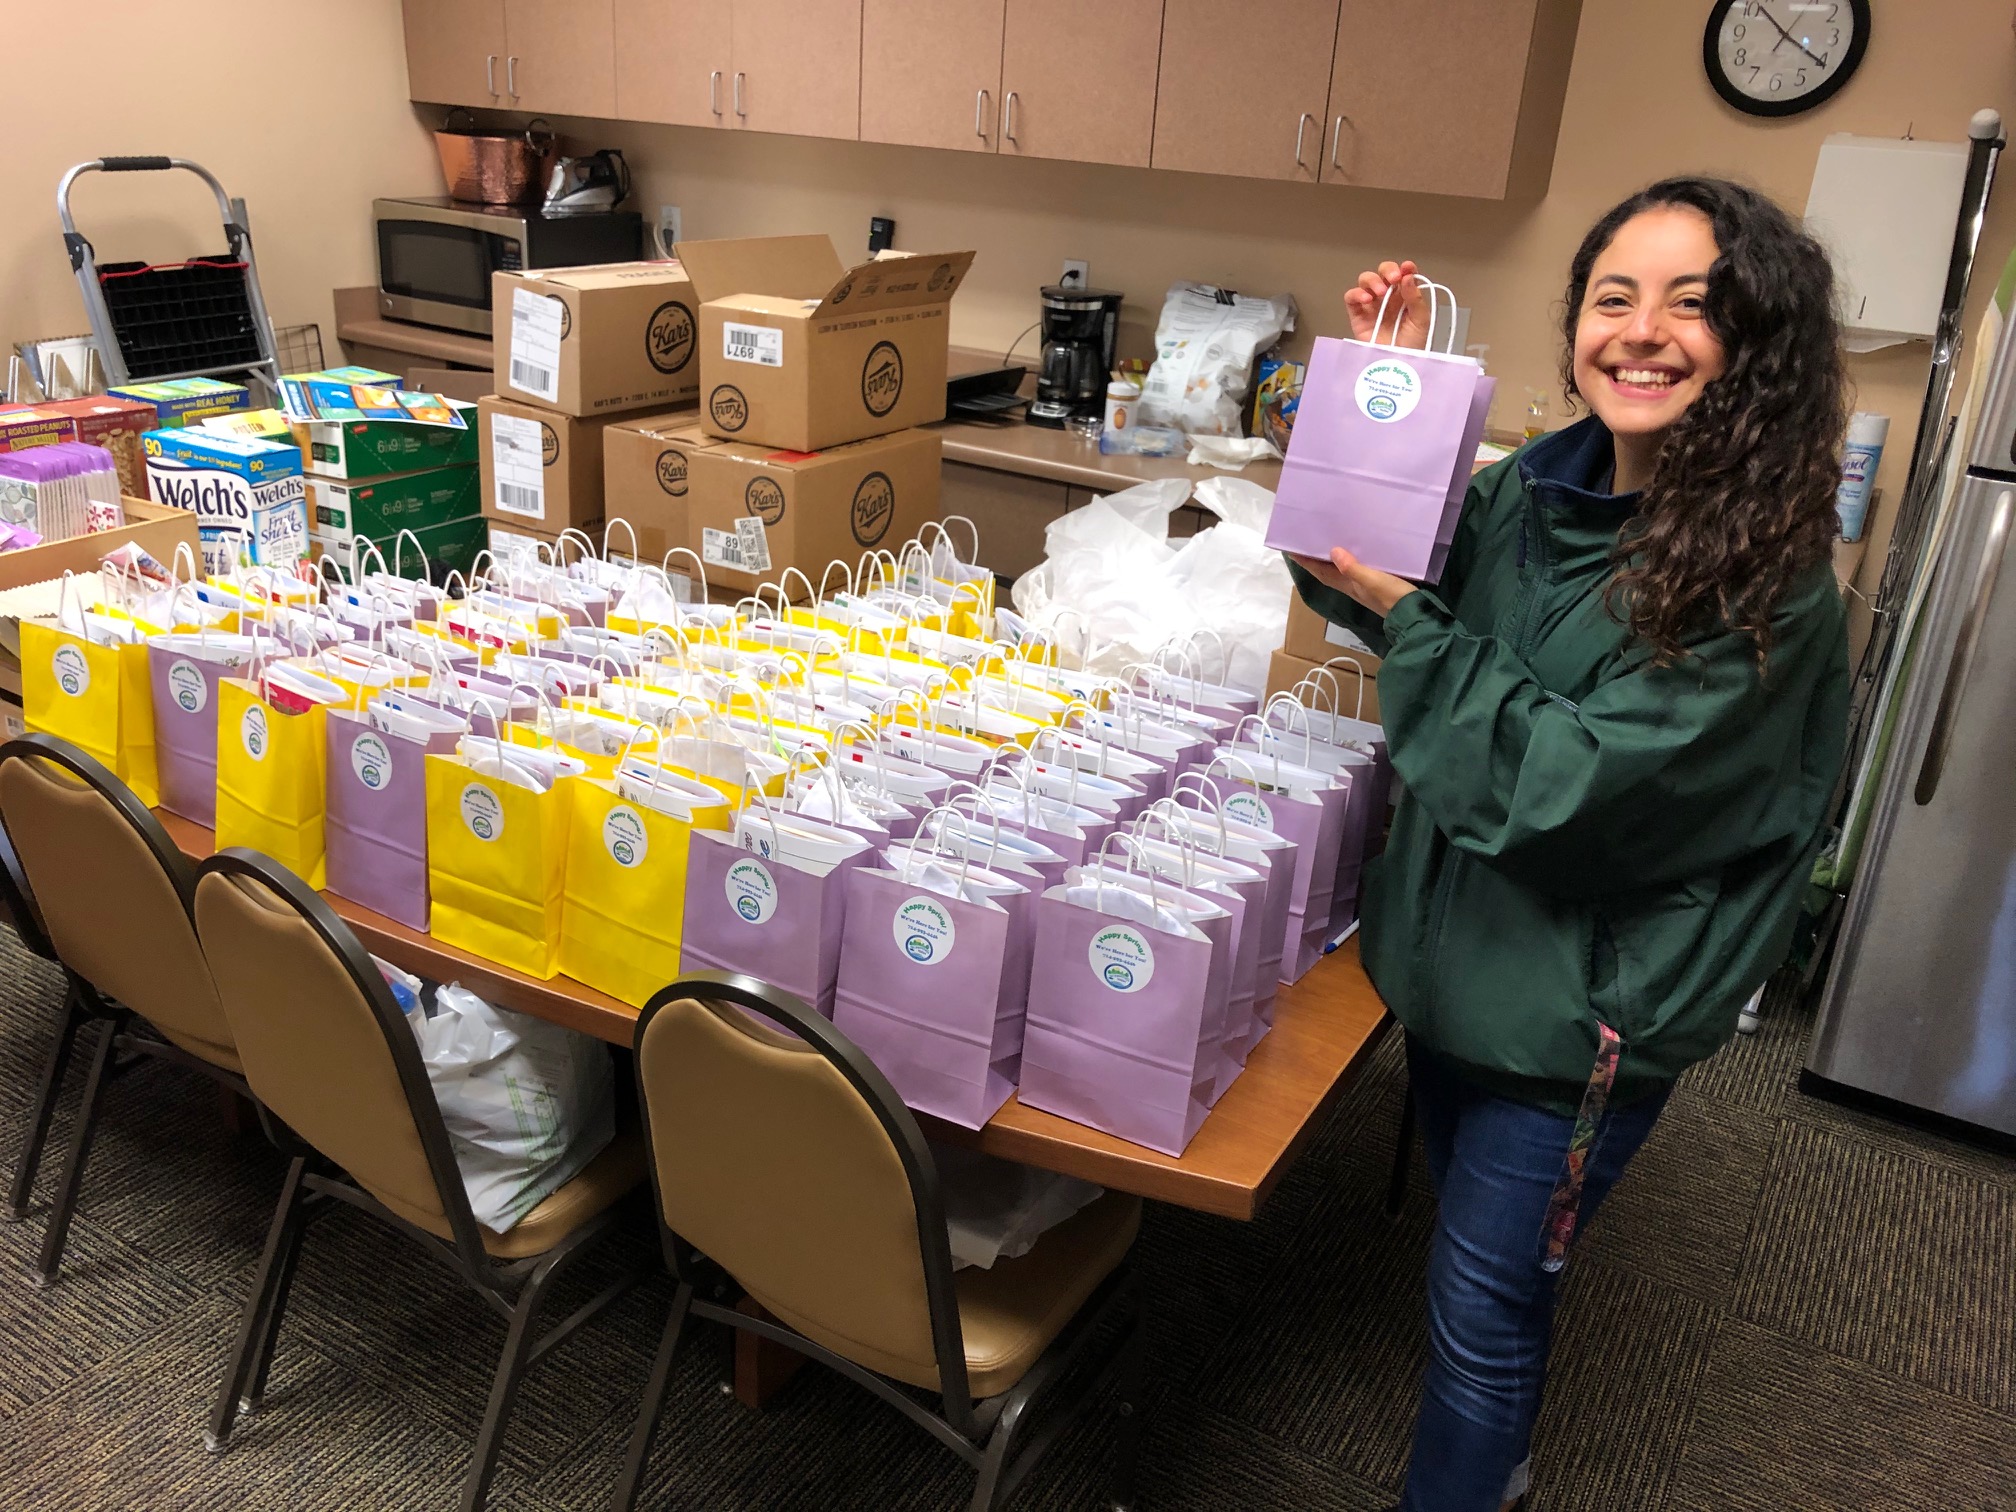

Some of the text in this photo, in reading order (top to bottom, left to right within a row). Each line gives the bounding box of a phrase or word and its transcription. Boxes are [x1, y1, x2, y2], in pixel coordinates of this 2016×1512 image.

[1743, 1, 1760, 18] 10
[1826, 3, 1839, 23] 2
[1733, 24, 1746, 43] 9
[1831, 28, 1840, 47] 3
[1734, 48, 1747, 66] 8
[1750, 66, 1761, 84] 7
[1769, 73, 1783, 92] 6
[1794, 68, 1807, 87] 5
[652, 318, 691, 350] Kar's
[727, 344, 755, 360] 8971
[866, 366, 899, 400] Kar's
[1367, 366, 1413, 386] Happy Spring!
[196, 398, 215, 408] REAL
[216, 394, 240, 405] HONEY
[715, 402, 744, 419] Kar's
[8, 425, 40, 437] ROASTED
[40, 421, 71, 432] PEANUTS
[145, 438, 162, 457] 90
[251, 460, 264, 472] 90
[661, 462, 688, 477] Kar's
[1843, 456, 1871, 471] ysol
[152, 474, 249, 519] Welch's
[254, 479, 304, 507] Welch's
[750, 490, 781, 506] Kar's
[857, 489, 890, 523] Kar's
[733, 866, 753, 875] Happy
[903, 904, 948, 929] Happy Spring!
[1098, 933, 1146, 956] Happy Spring!
